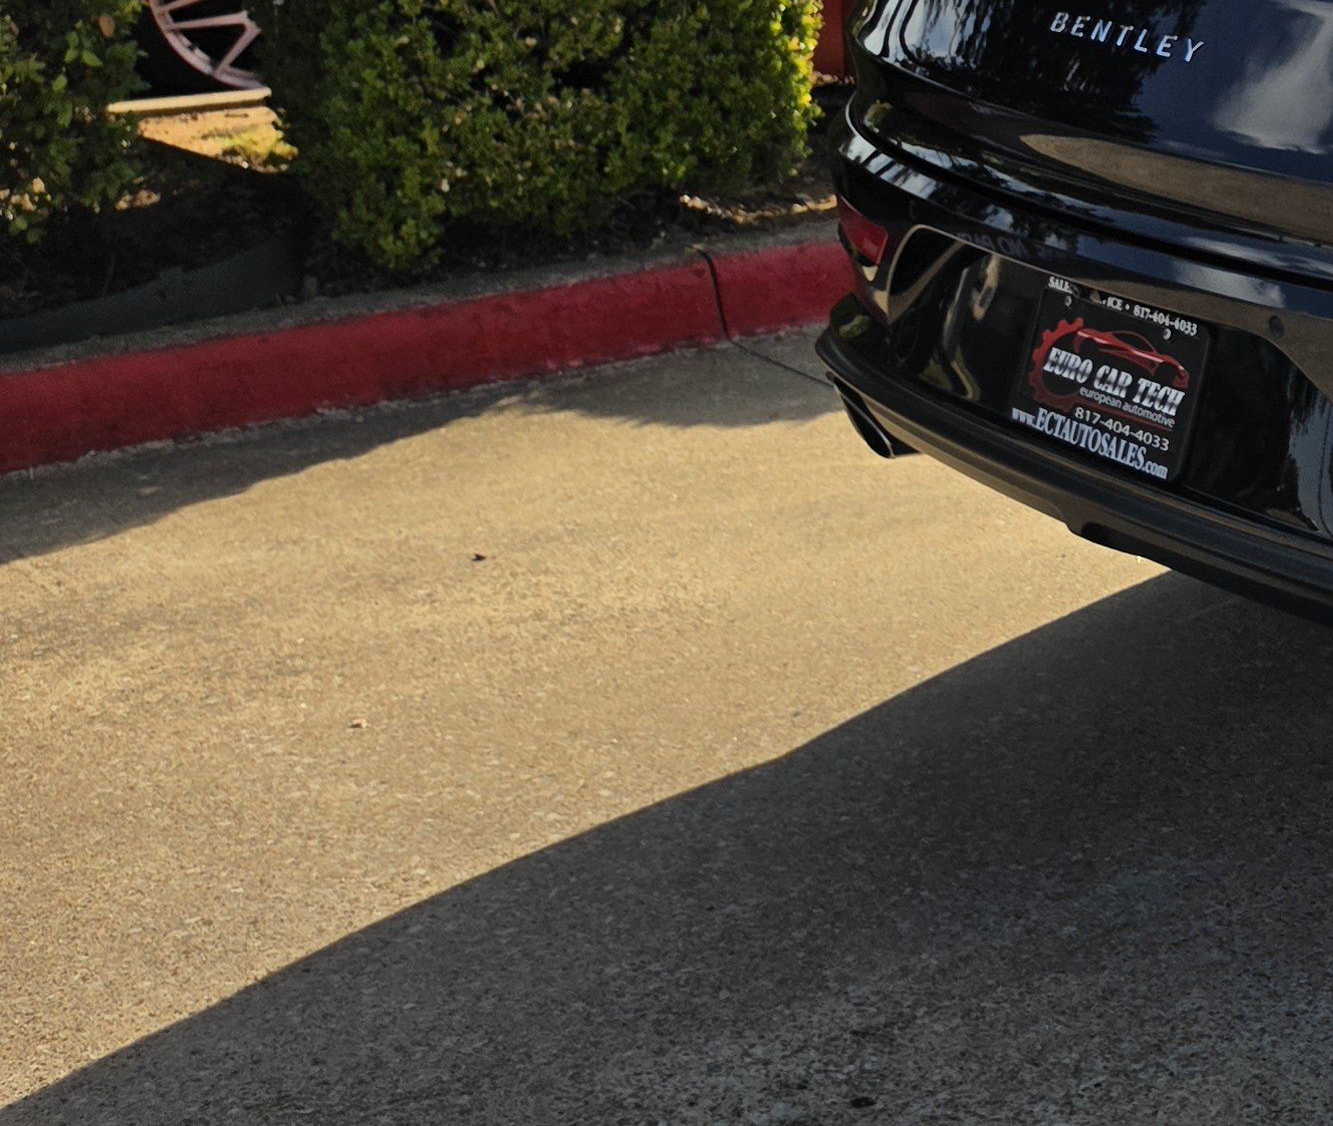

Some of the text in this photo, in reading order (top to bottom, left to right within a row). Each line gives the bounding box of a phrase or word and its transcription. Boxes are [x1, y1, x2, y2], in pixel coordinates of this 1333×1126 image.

[1050, 11, 1205, 63] BENTLEY
[1043, 346, 1186, 417] EURO CAR TECH
[1079, 386, 1175, 428] european automotive
[1011, 407, 1169, 480] www.ECTAUTOSALES.com
[1074, 406, 1170, 452] 817-404-4033
